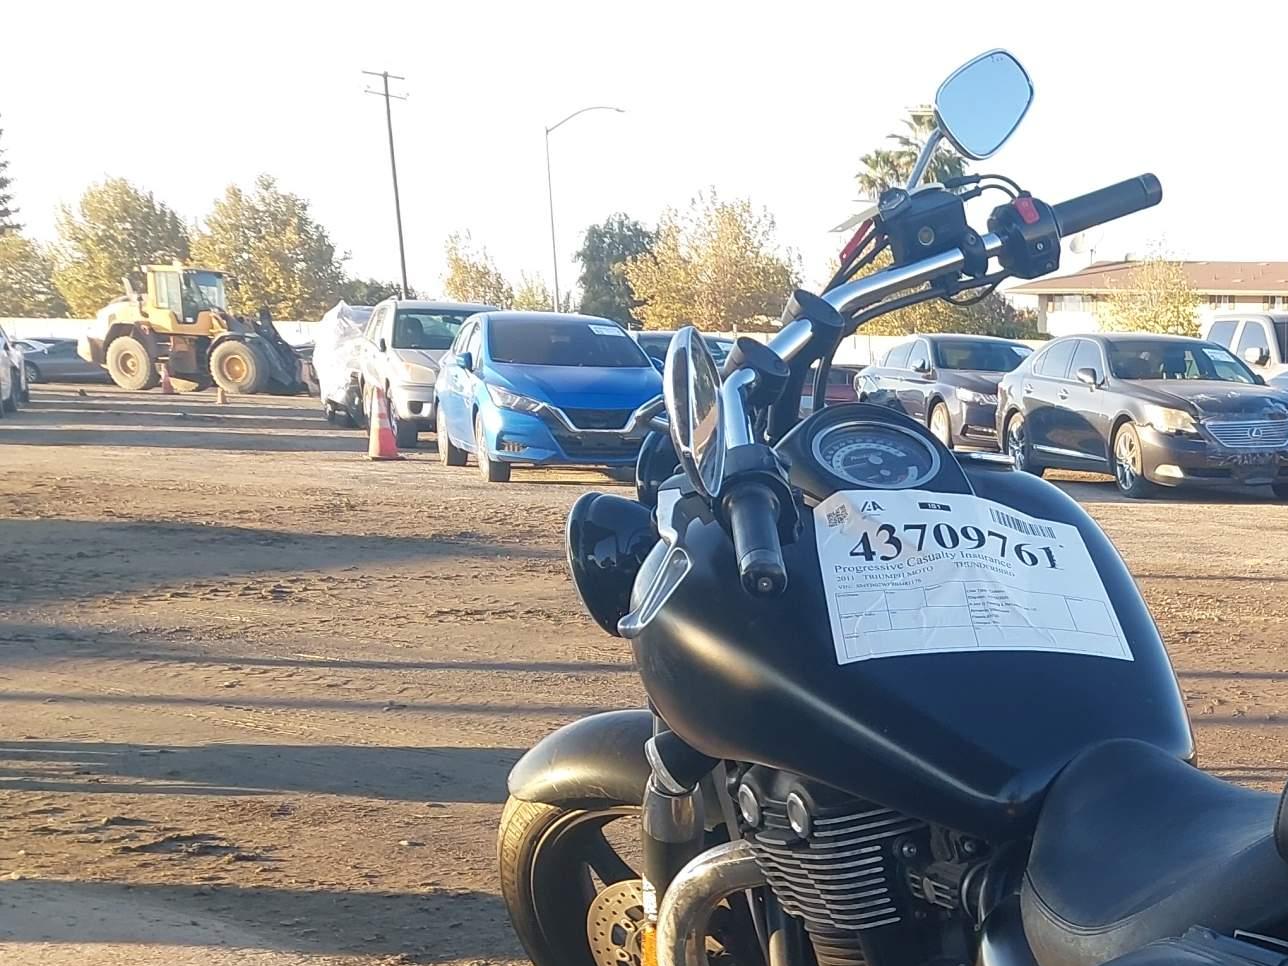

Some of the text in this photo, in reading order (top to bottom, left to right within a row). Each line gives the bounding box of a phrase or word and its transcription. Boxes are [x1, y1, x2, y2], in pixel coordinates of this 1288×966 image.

[849, 522, 1062, 569] 43709761
[834, 550, 1012, 574] Progressive Casualty Insurance
[907, 565, 933, 576] MOTO
